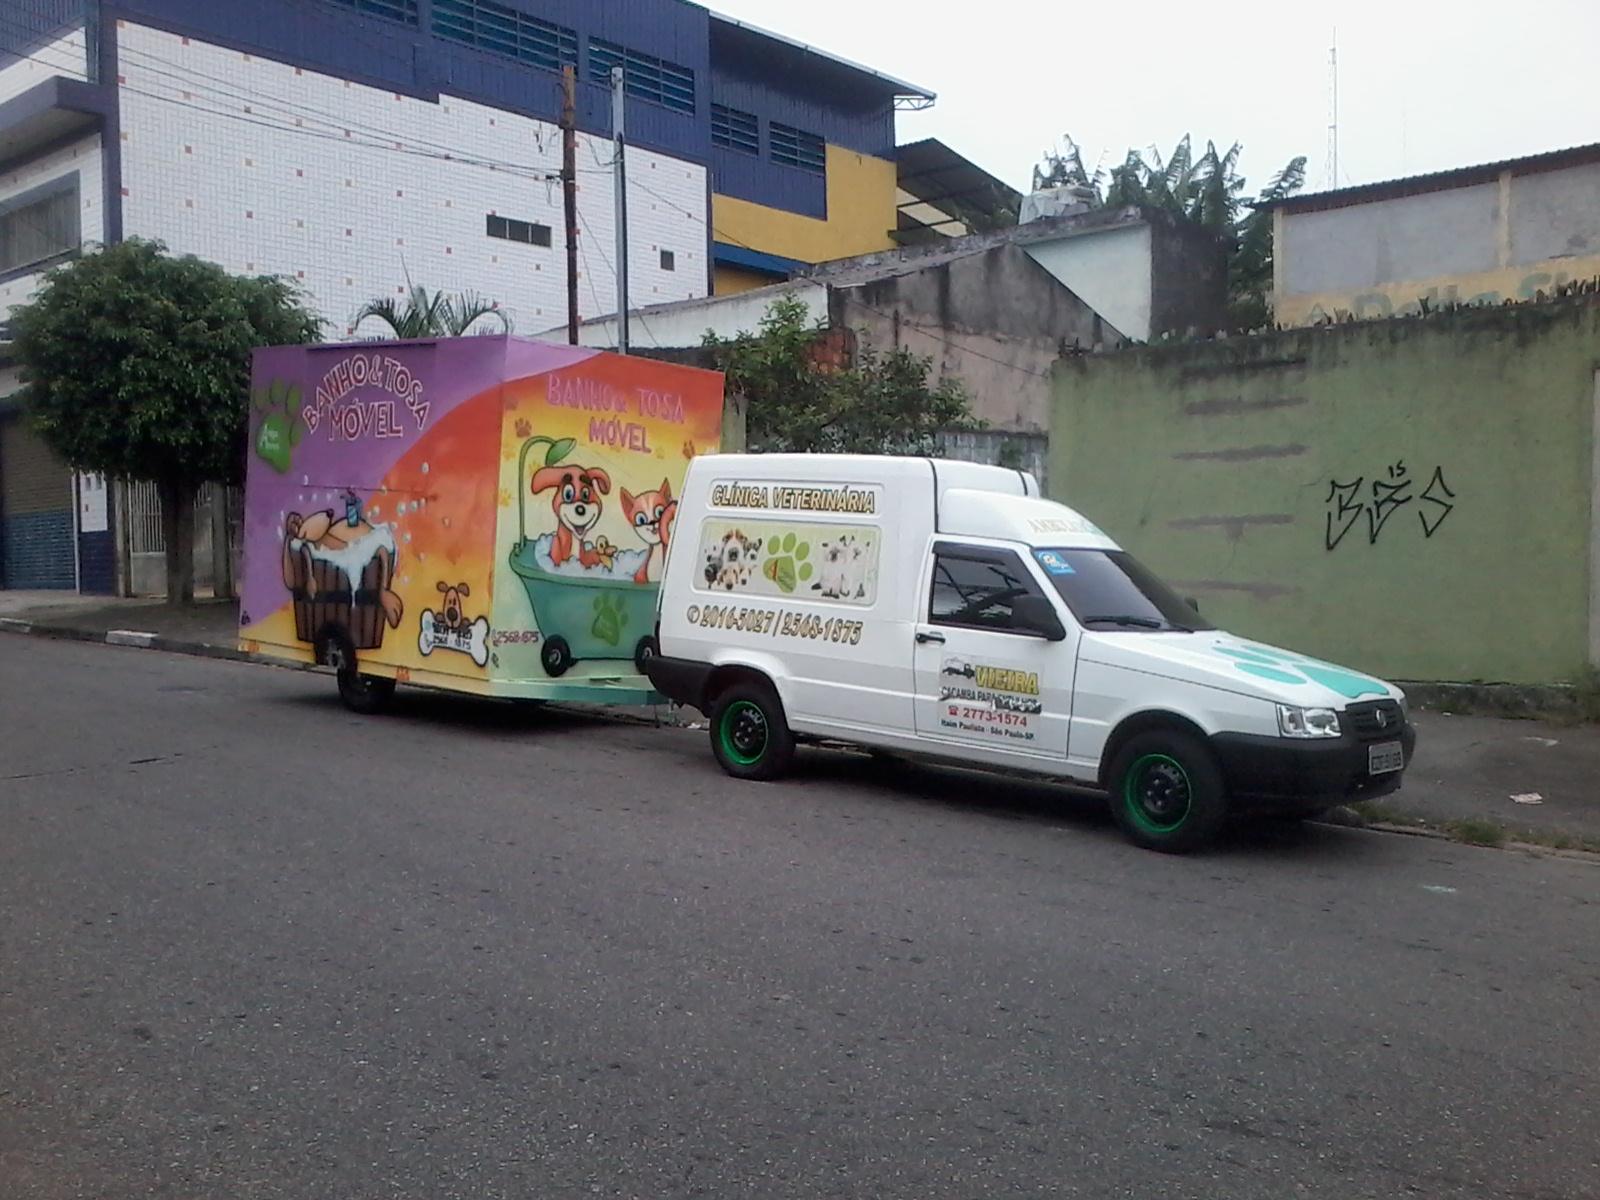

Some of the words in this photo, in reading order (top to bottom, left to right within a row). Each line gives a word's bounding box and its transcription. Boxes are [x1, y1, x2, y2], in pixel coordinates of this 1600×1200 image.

[328, 398, 403, 441] MÓVEL
[637, 388, 685, 424] TOSA
[589, 415, 652, 453] MÓVEL
[712, 481, 768, 508] CLÍNICA
[773, 485, 875, 513] VETERINÁRIA
[975, 665, 1040, 695] VIEIRA
[963, 707, 1027, 727] 2773-1574
